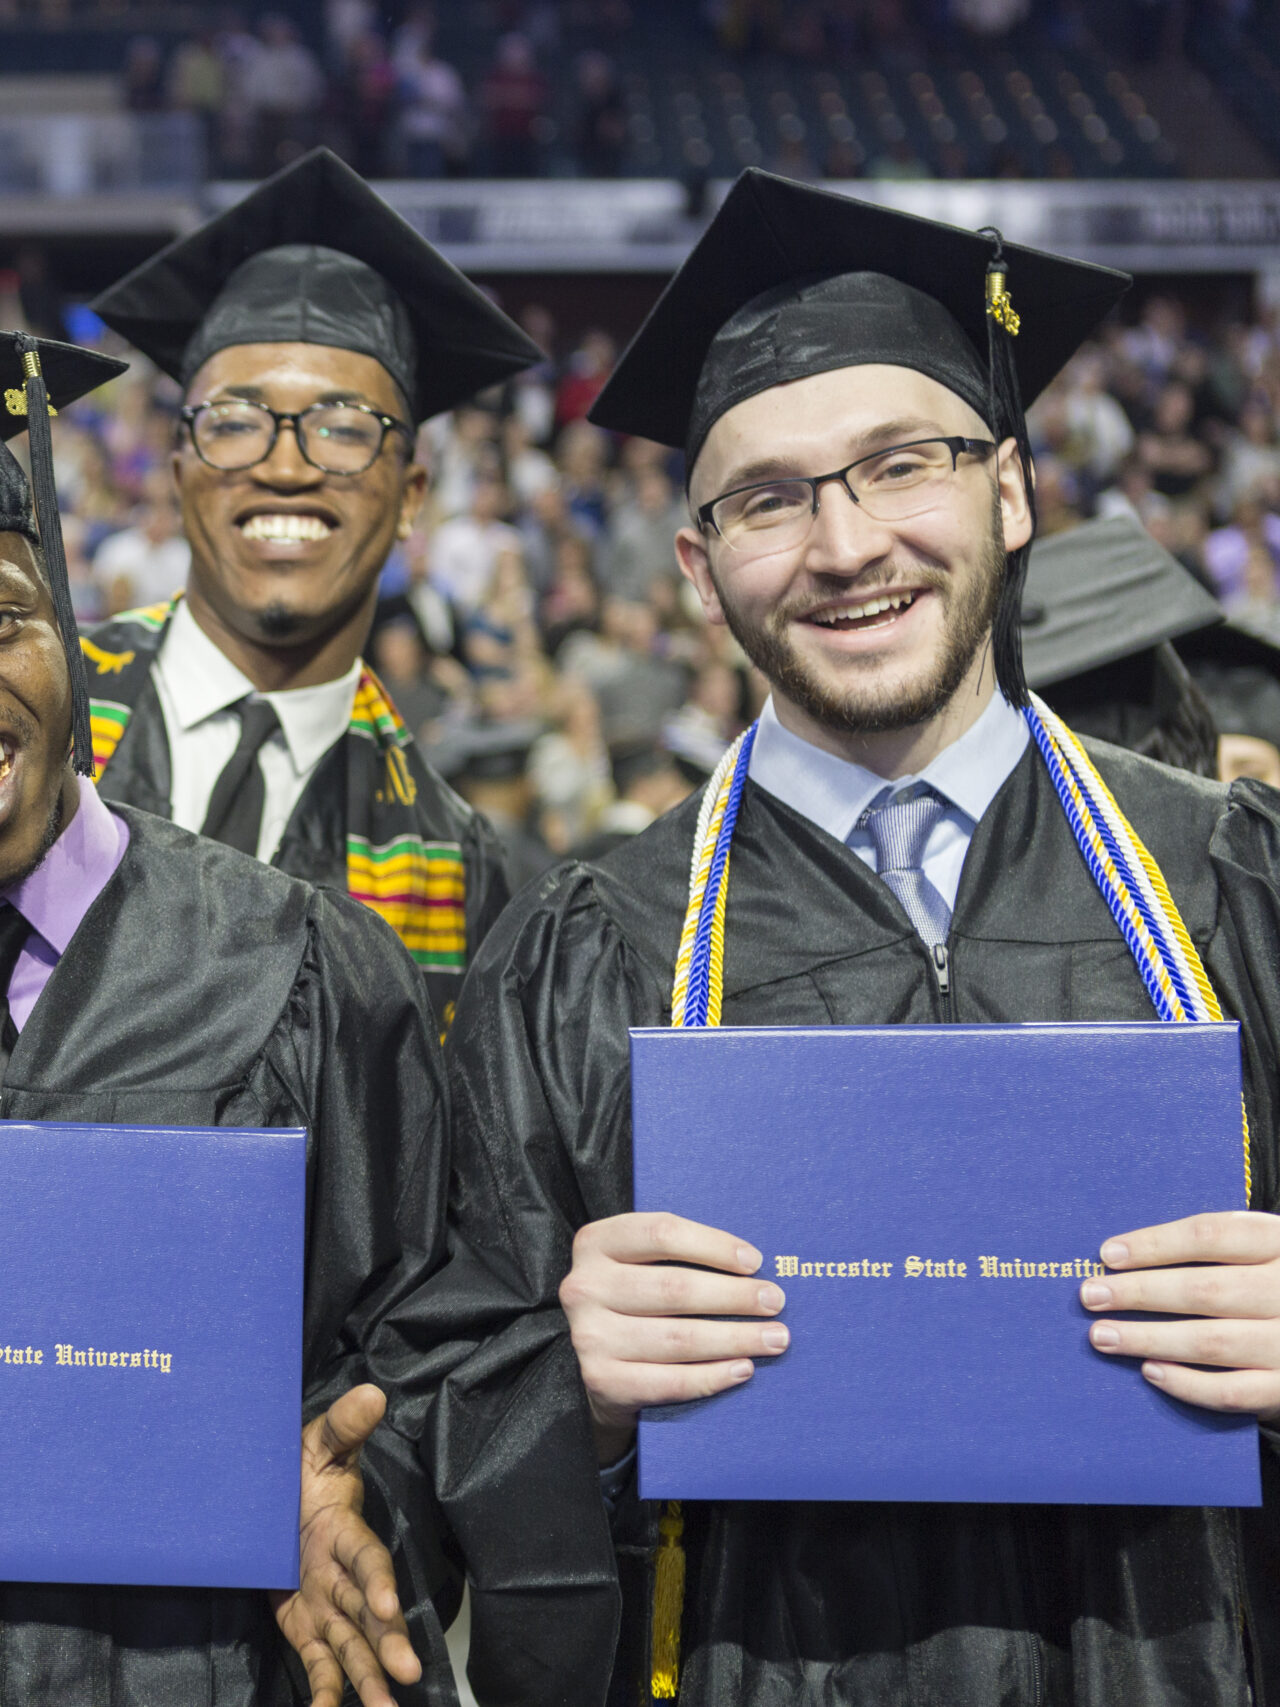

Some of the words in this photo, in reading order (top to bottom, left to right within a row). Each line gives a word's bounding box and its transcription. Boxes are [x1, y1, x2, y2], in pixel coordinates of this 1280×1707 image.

[775, 1255, 893, 1278] Worcester
[904, 1255, 967, 1278] State
[55, 1343, 173, 1373] University
